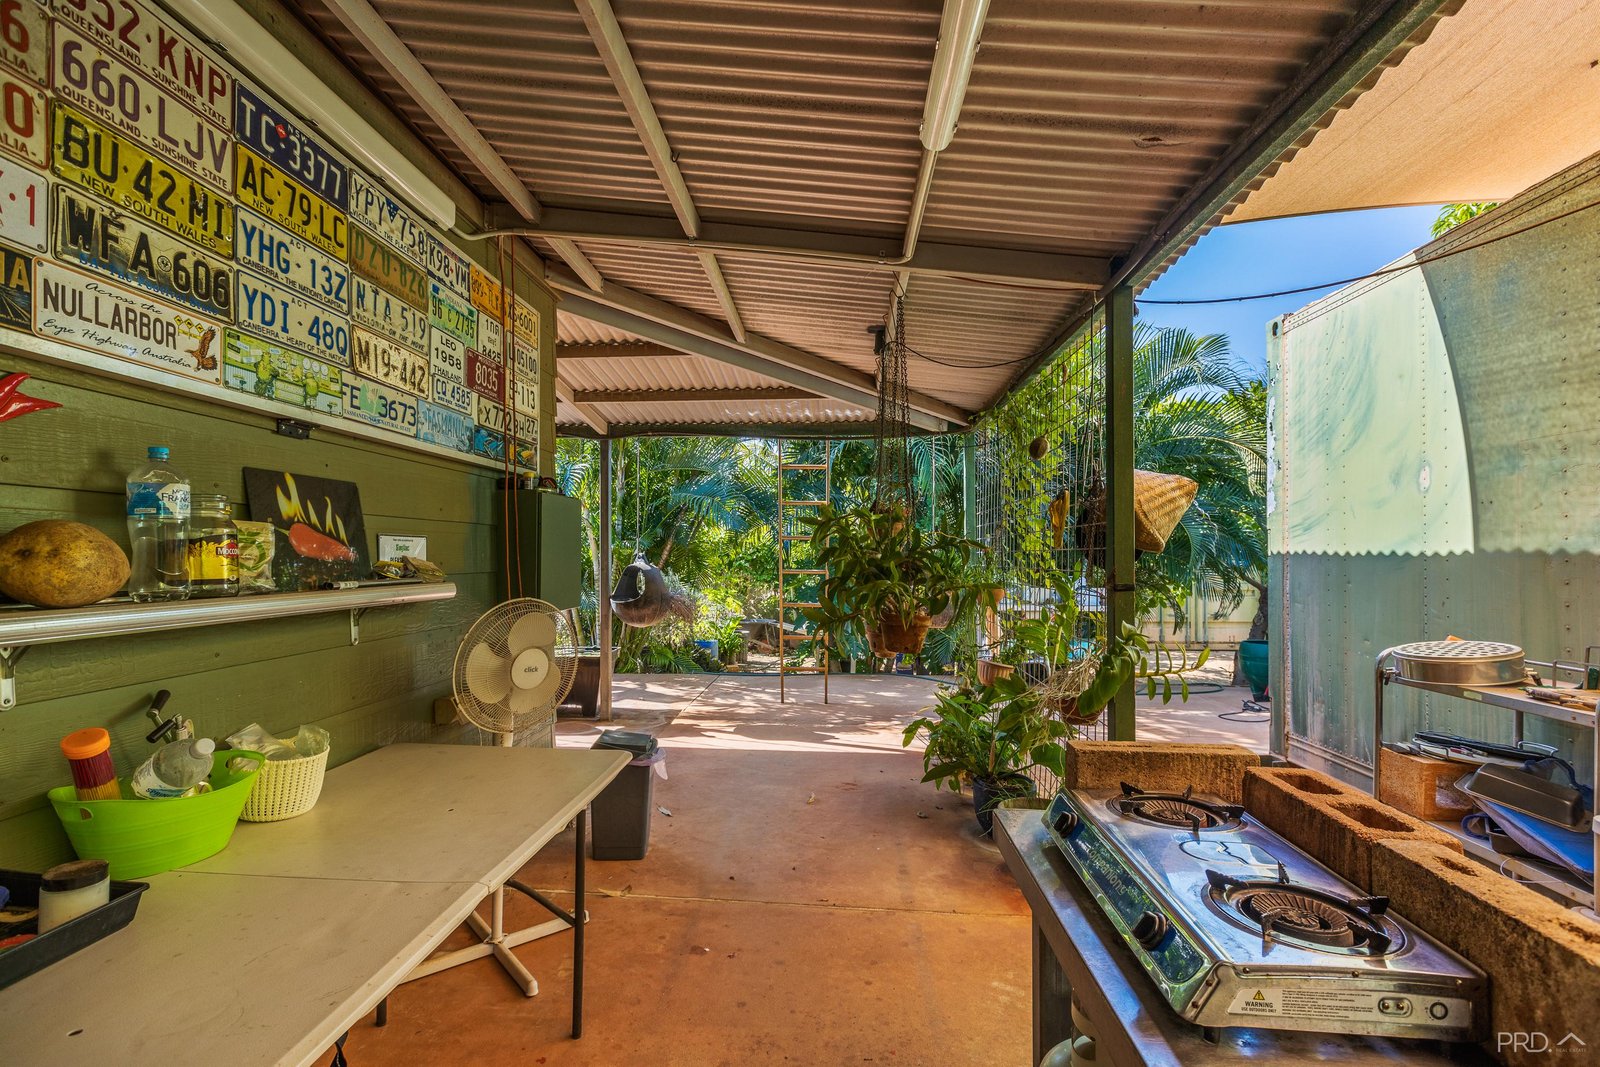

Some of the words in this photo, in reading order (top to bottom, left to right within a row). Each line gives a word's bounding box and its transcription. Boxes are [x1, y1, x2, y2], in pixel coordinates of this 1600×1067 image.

[61, 5, 141, 65] QUEENSLAND
[152, 66, 197, 105] SUNSHINE
[202, 102, 228, 126] STATE
[62, 85, 141, 138] QUEENSLAND
[152, 137, 197, 171] SUNSHINE
[202, 167, 228, 189] STATE
[81, 172, 115, 197] NEW
[123, 194, 169, 226] SOUTH
[176, 223, 217, 248] WALES
[353, 177, 385, 226] YPY
[252, 199, 273, 215] NEW
[278, 213, 307, 237] SOUTH
[311, 231, 337, 253] WALES
[383, 231, 393, 243] THE
[395, 239, 410, 254] PLACE
[85, 282, 136, 305] Across
[140, 302, 163, 315] the
[173, 250, 230, 309] 606
[242, 256, 279, 280] CANBERRA
[285, 276, 298, 288] THE
[323, 296, 344, 311] CAPITAL
[43, 278, 177, 350] NULLARBOR
[43, 318, 76, 336] Eyre
[81, 328, 138, 356] Highway
[142, 347, 192, 369] Australia
[242, 319, 280, 340] CANBERRA
[286, 336, 306, 350] HEART
[307, 344, 315, 352] OF
[317, 347, 327, 357] THE
[328, 352, 348, 364] NATION
[434, 347, 462, 370] 1958
[440, 335, 456, 351] LEO
[433, 364, 462, 384] THAILAND
[475, 362, 498, 391] 8035
[378, 395, 416, 427] 3673
[524, 665, 539, 673] click
